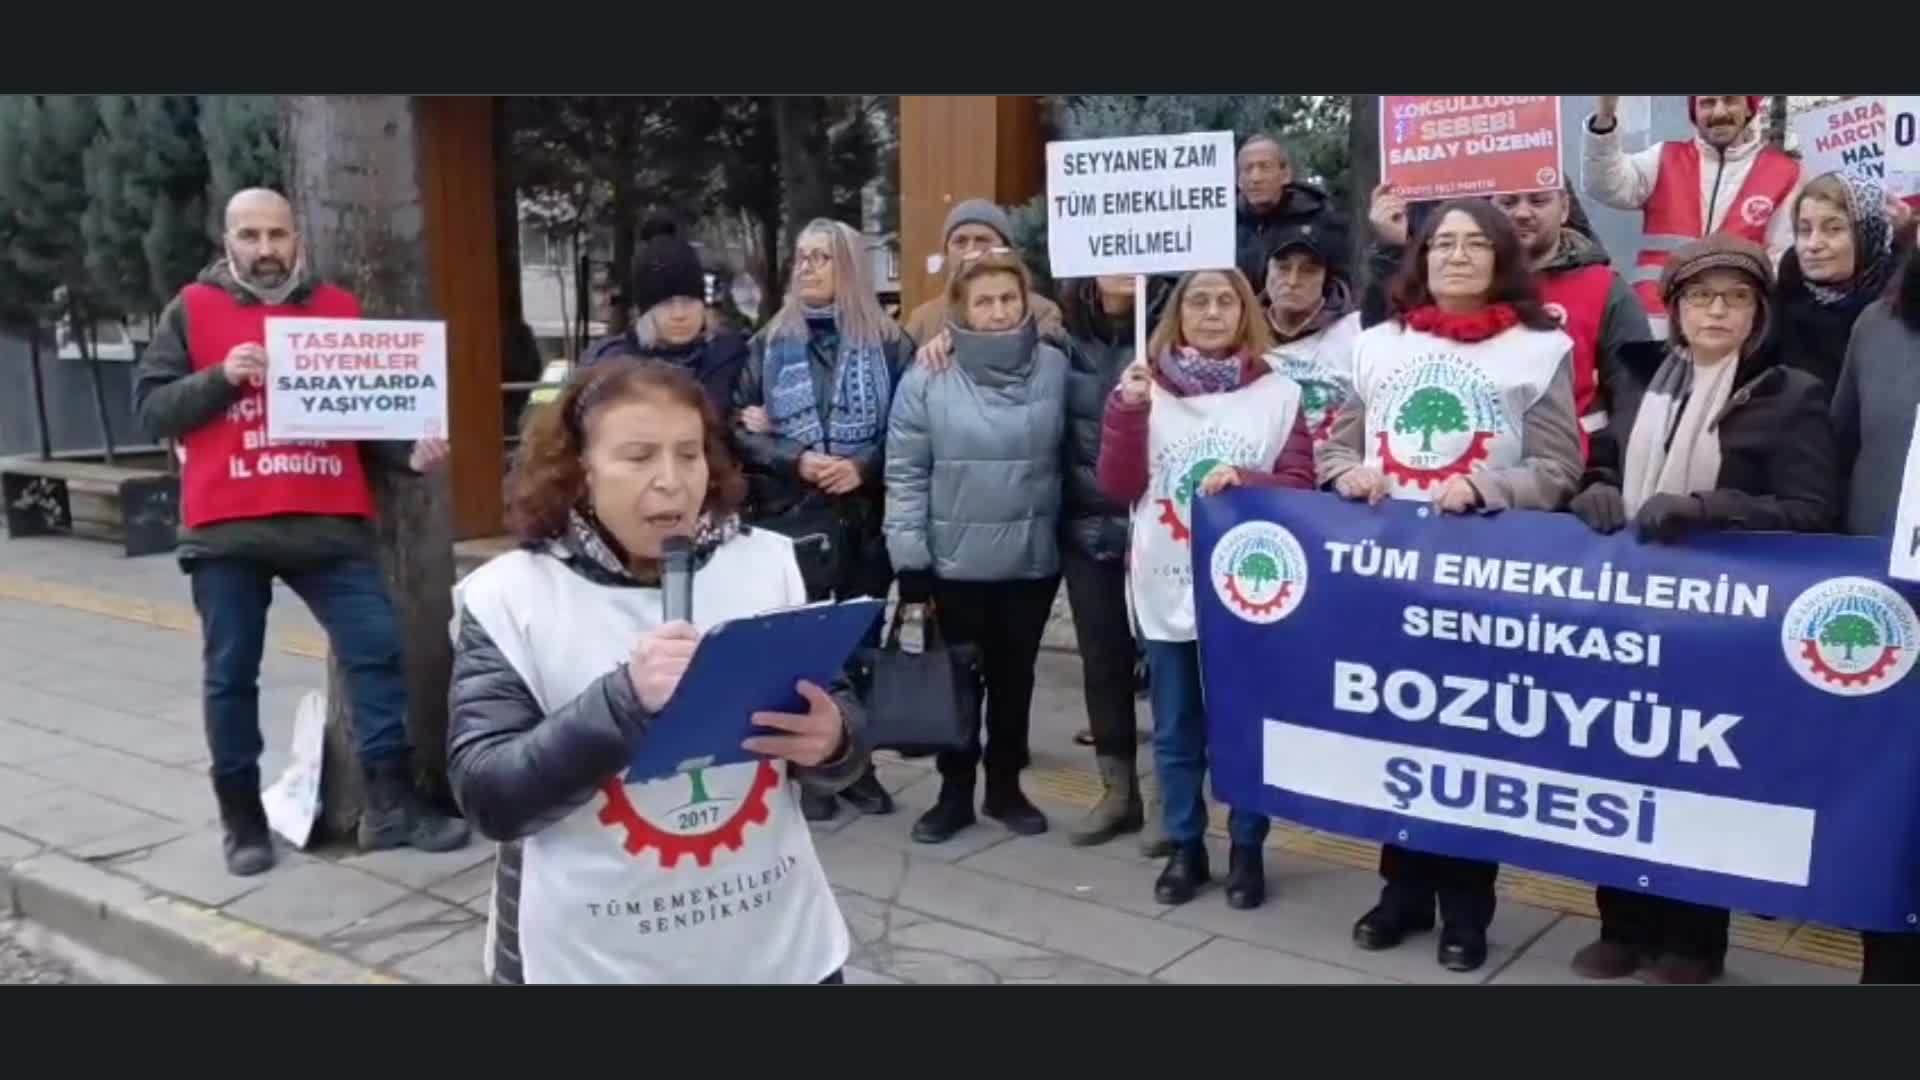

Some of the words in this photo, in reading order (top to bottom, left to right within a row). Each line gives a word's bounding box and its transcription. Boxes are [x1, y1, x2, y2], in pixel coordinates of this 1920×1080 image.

[1063, 148, 1167, 176] SEYYANEN
[1174, 144, 1217, 168] ZAM
[1390, 141, 1460, 166] SARAY
[1055, 191, 1097, 219] TÜM
[1103, 184, 1227, 215] EMEKLİLERE
[1089, 224, 1193, 257] VERİLMELİ
[288, 332, 425, 350] TASARRUF
[296, 353, 418, 371] DİYENLER
[277, 374, 436, 391] SARAYLARDA
[302, 395, 416, 414] YAŞIYOR!
[229, 455, 252, 478] İL
[257, 451, 343, 477] ÖRGÜTÜ
[1324, 540, 1420, 581] TÜM
[1433, 553, 1769, 618] EMEKLİLERİN
[1403, 605, 1661, 667] SENDİKASI
[1333, 659, 1745, 769] BOZÜYÜK
[1383, 756, 1656, 844] ŞUBESİ
[677, 806, 721, 830] 2017
[587, 898, 642, 917] TÜM
[638, 890, 772, 935] SENDİKASI
